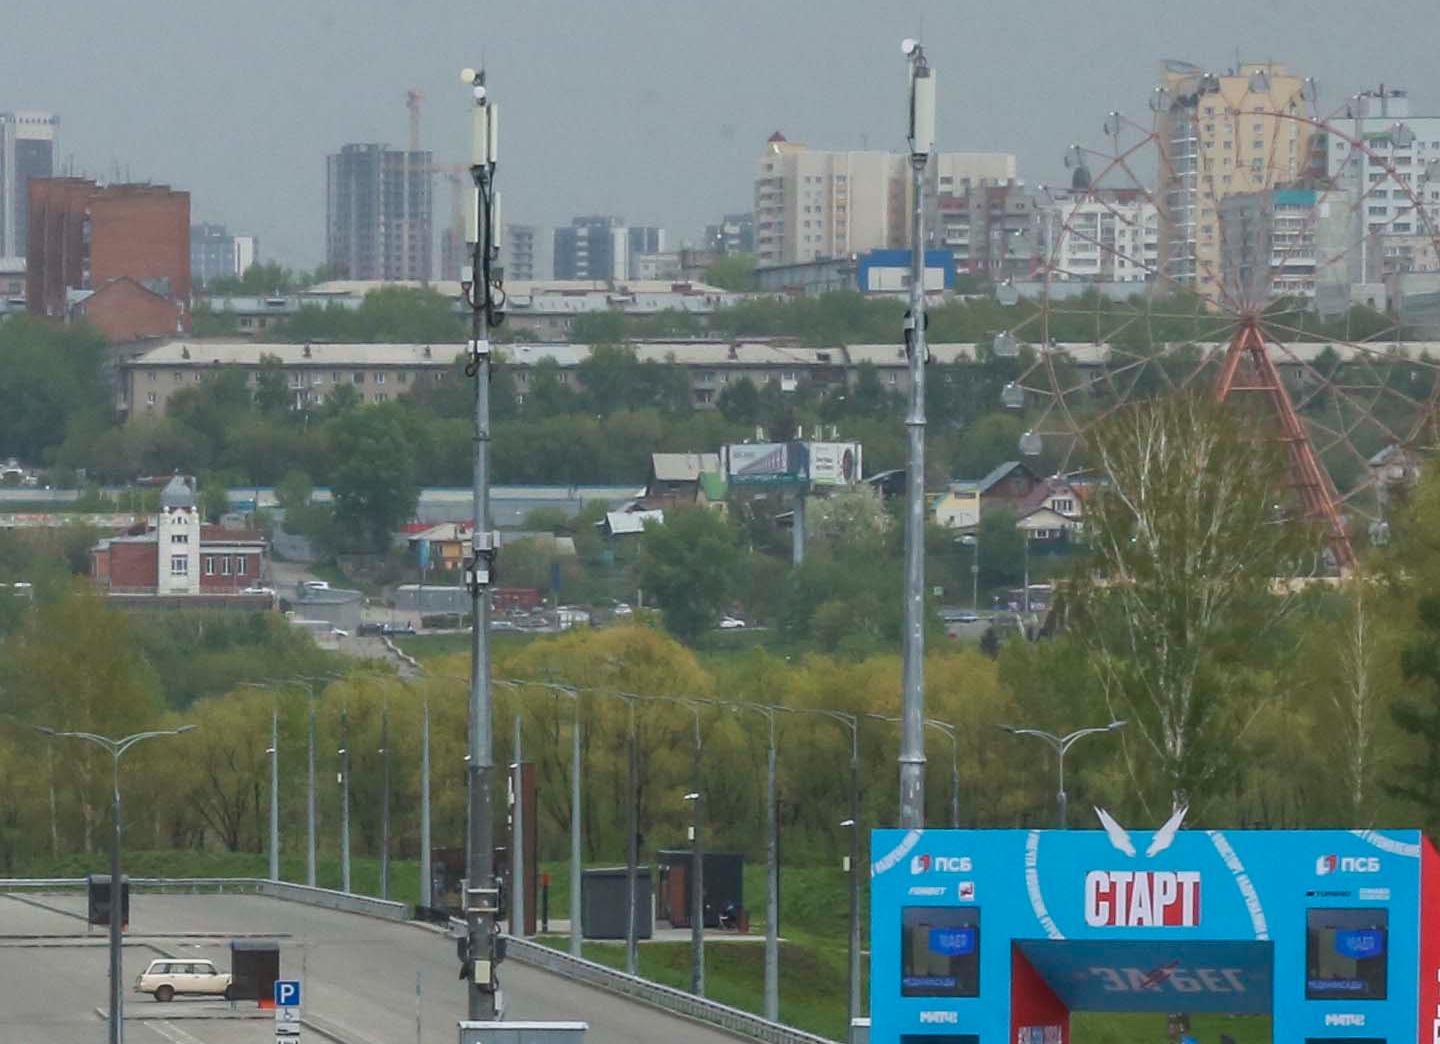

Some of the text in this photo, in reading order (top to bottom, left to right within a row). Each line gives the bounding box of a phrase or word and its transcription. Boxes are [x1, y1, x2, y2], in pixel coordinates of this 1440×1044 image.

[935, 857, 973, 872] ПСБ
[1341, 857, 1381, 872] ПСБ
[1084, 870, 1201, 928] СТАРТ
[281, 984, 295, 1004] P
